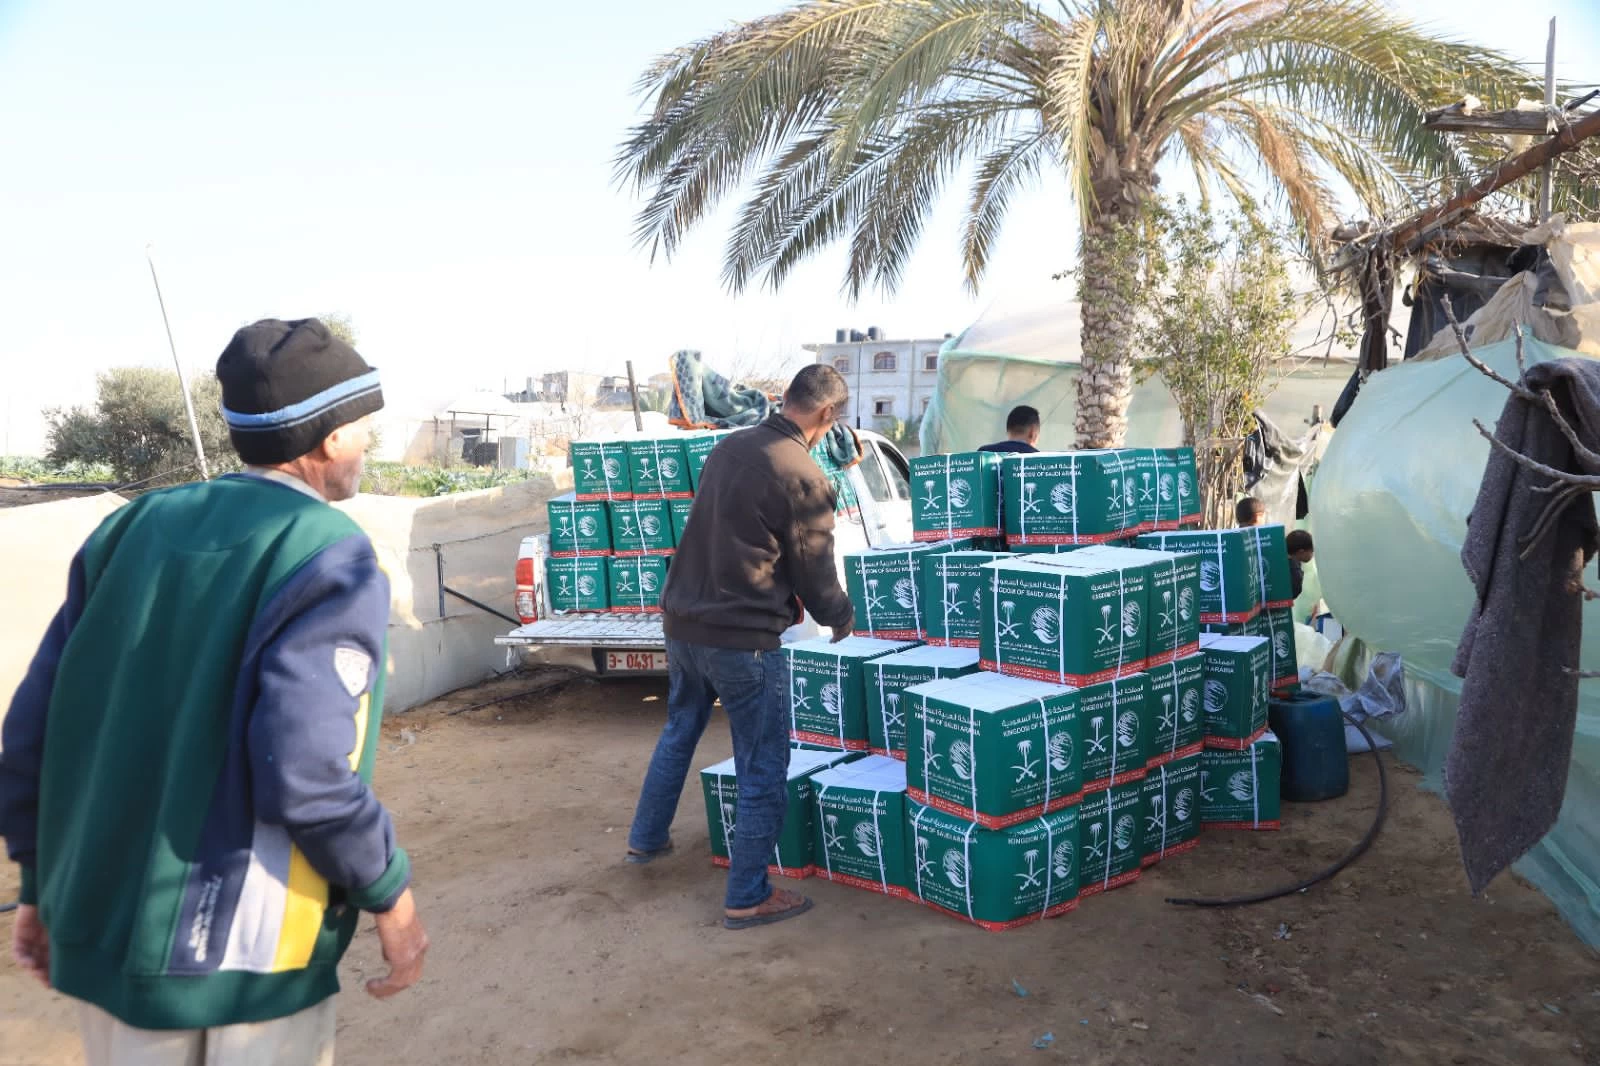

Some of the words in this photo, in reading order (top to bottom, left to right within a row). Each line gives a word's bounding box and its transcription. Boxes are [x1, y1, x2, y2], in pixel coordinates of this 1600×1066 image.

[1200, 540, 1226, 548] الملكة
[990, 577, 1018, 587] السعوية
[1042, 582, 1068, 592] الملكة
[990, 585, 1016, 594] KGDOM
[1025, 589, 1043, 597] SAUDI
[1044, 591, 1068, 600] ARABA
[609, 653, 669, 669] 3-0431-
[1111, 697, 1126, 706] SUDI
[914, 712, 934, 724] KINDOM
[935, 718, 942, 726] OF
[959, 724, 980, 736] ARAIA
[957, 714, 980, 728] الملكة
[1002, 724, 1030, 737] KINGDOM
[1030, 722, 1038, 730] OF
[1039, 717, 1055, 728] SUDI
[1056, 713, 1075, 724] ARABIA
[864, 806, 886, 815] ARBIA
[953, 835, 978, 844] ARAIA
